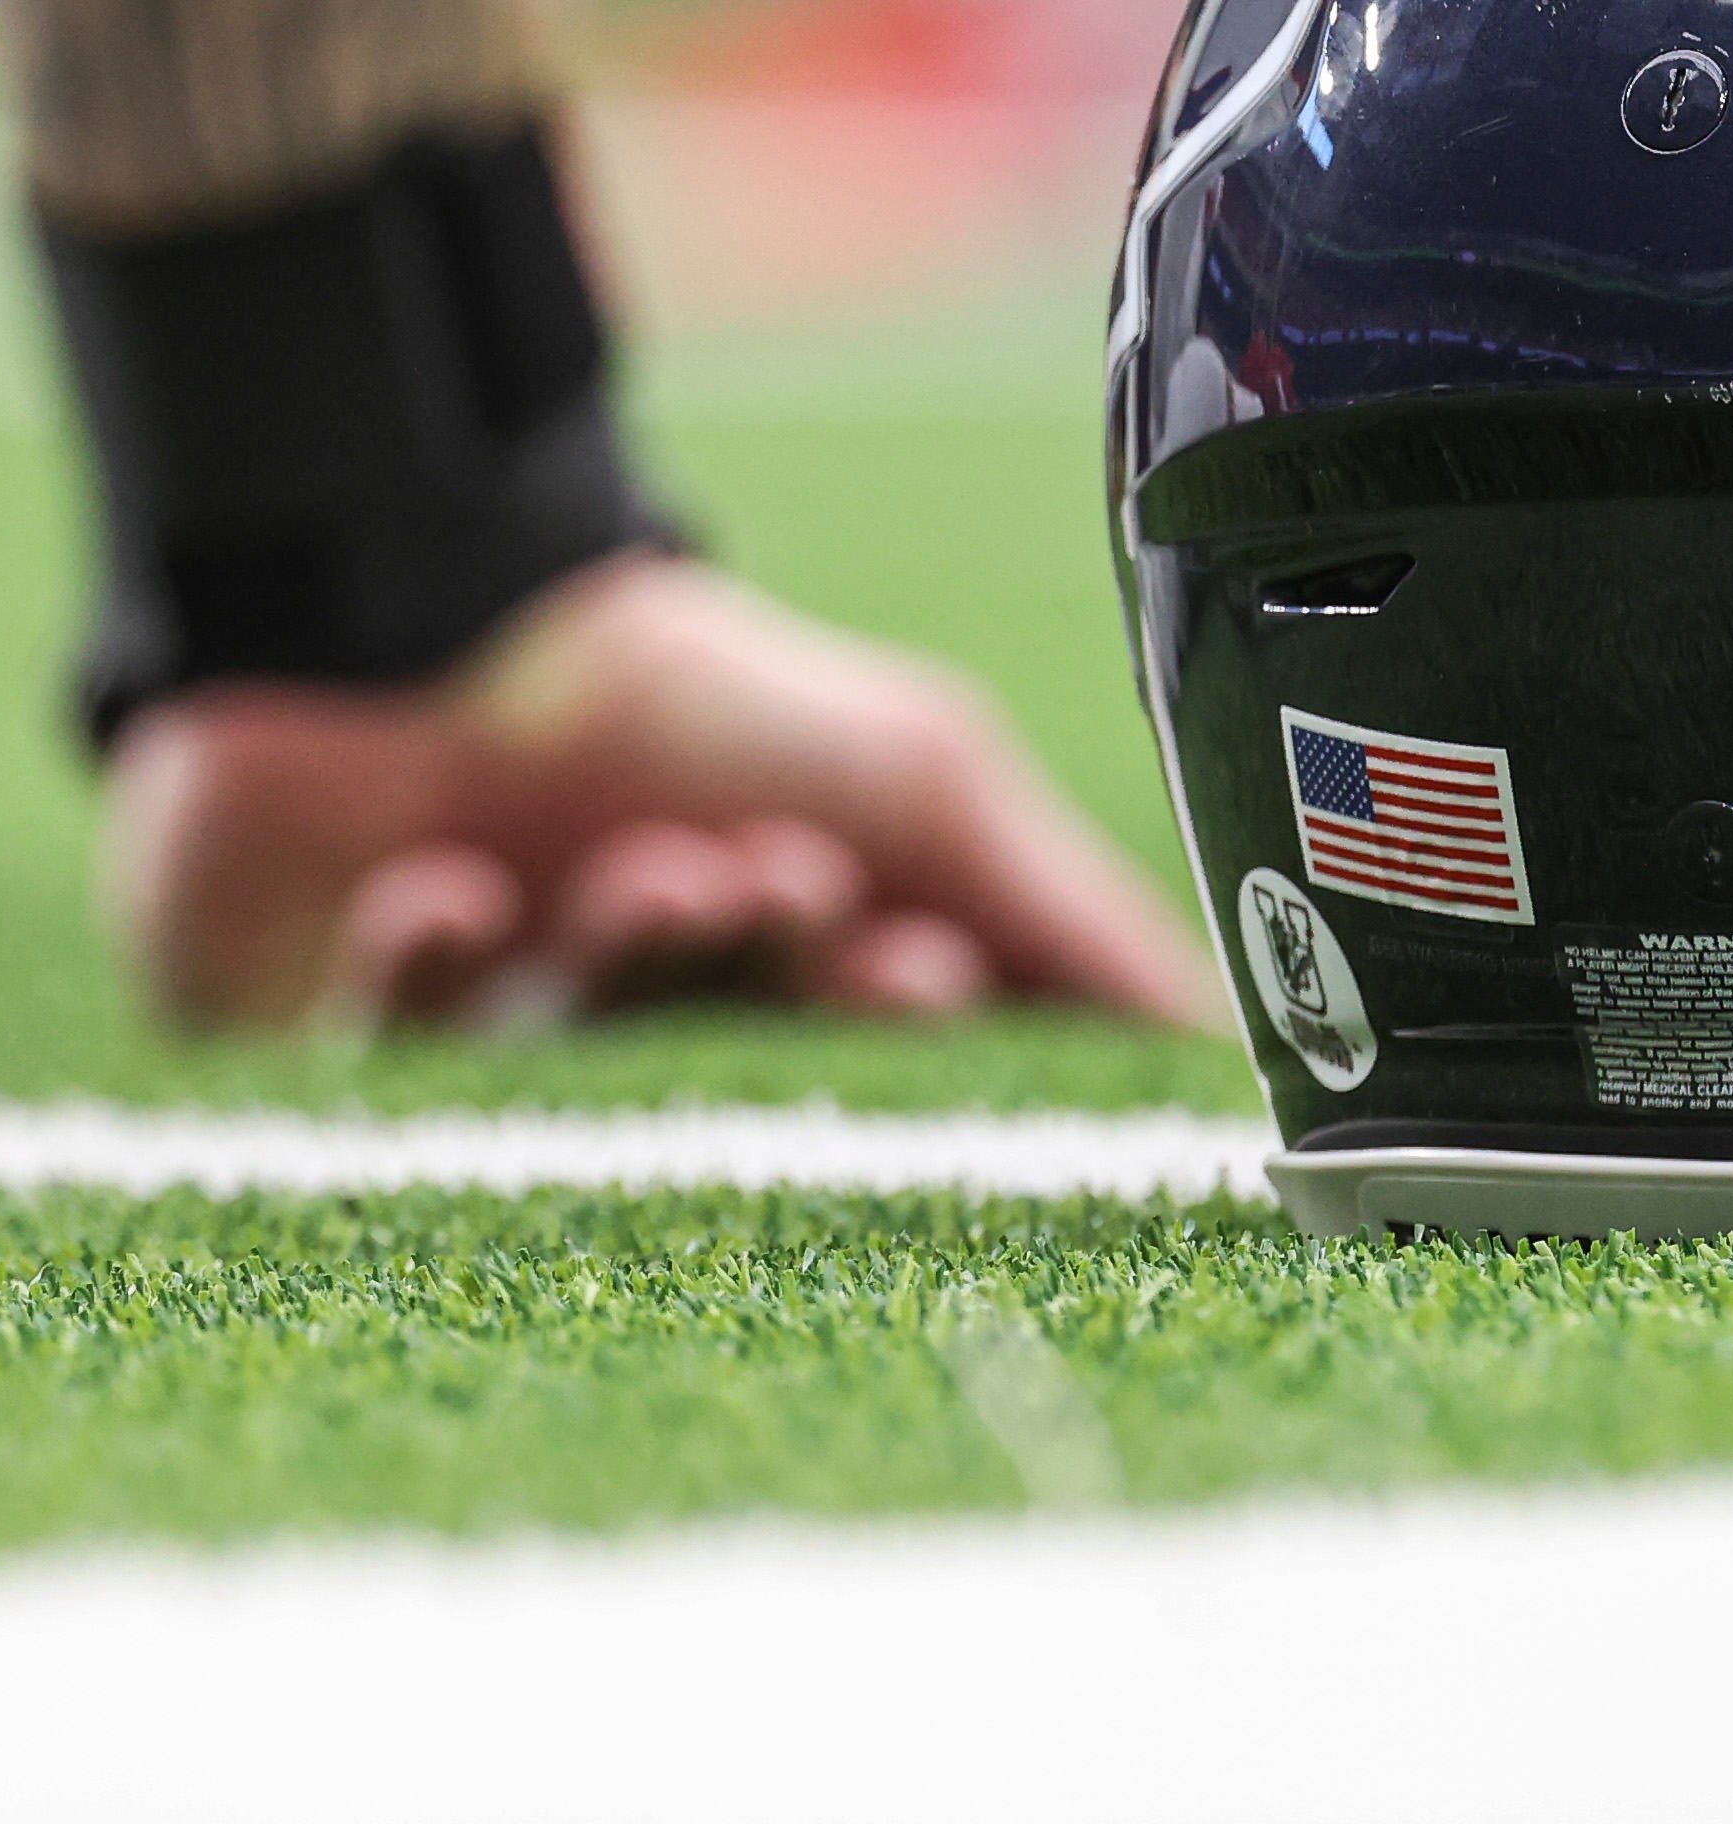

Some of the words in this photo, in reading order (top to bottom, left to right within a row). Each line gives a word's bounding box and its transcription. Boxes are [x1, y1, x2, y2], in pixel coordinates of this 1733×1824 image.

[1643, 1083, 1694, 1096] MEDICAL
[1626, 1094, 1636, 1106] to
[1641, 1096, 1683, 1109] another
[1689, 1098, 1711, 1110] and
